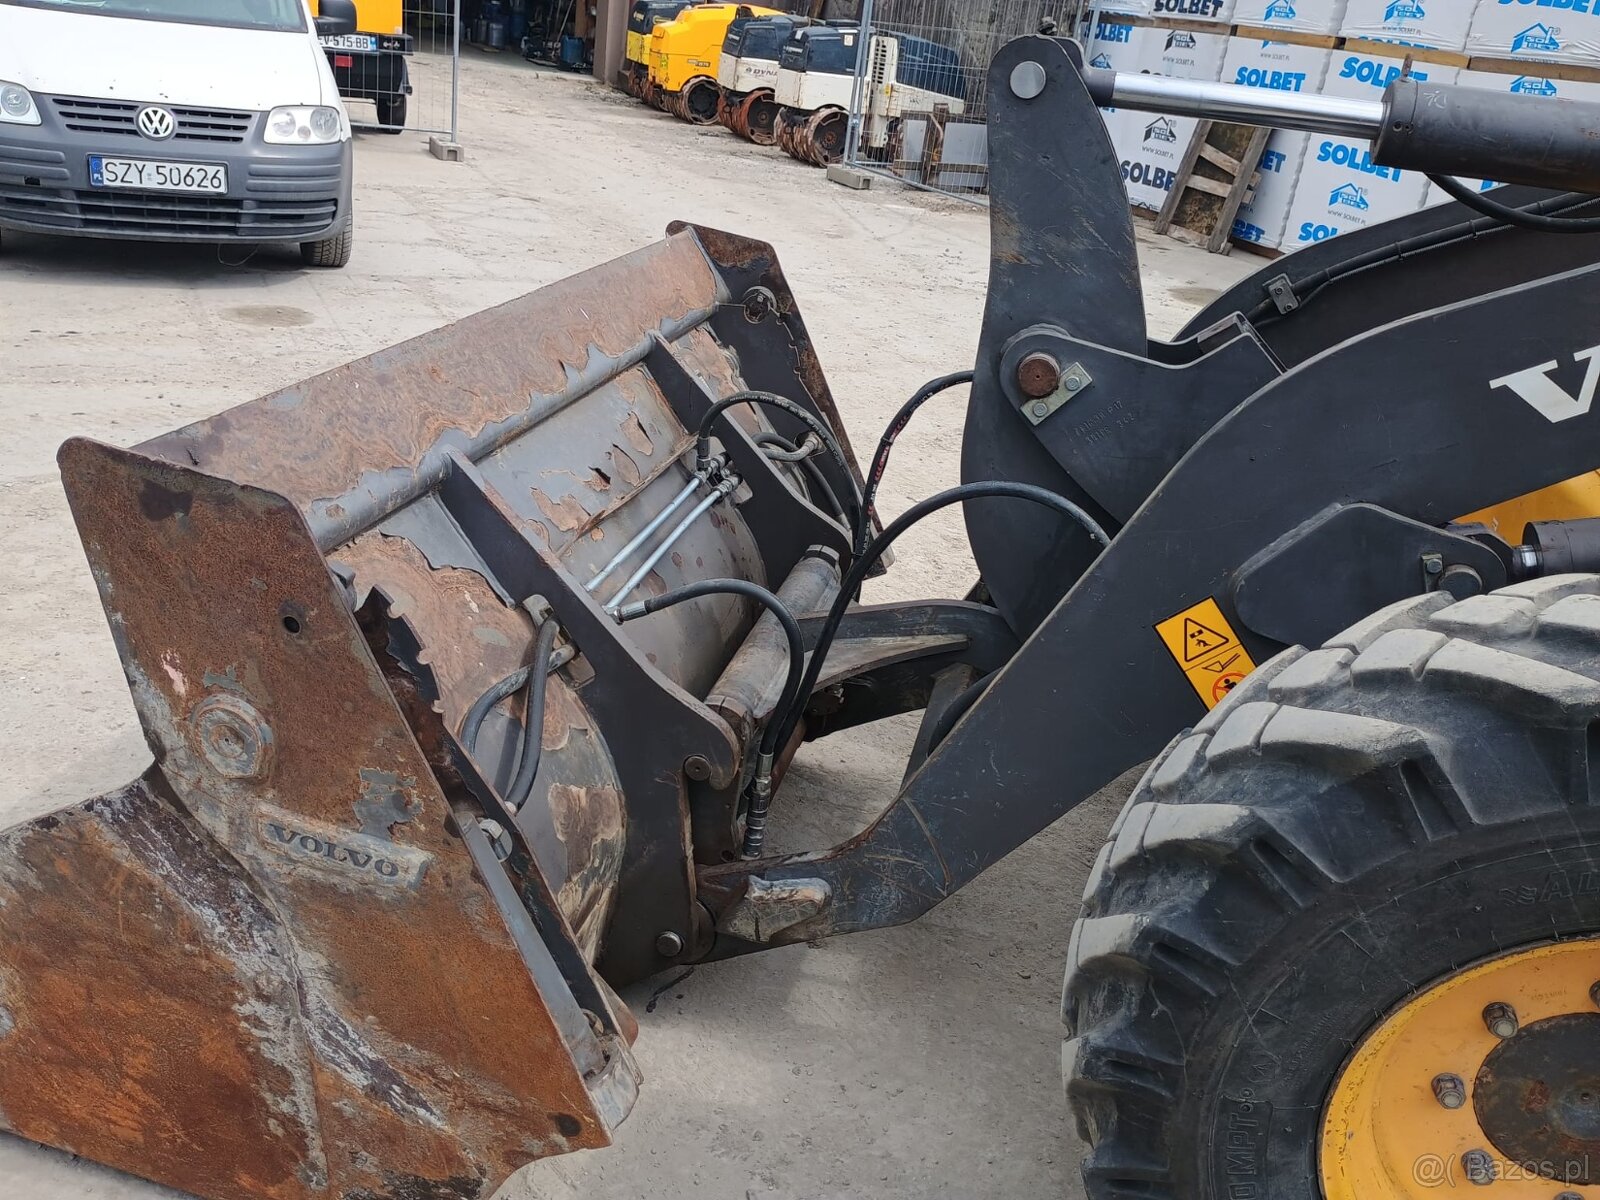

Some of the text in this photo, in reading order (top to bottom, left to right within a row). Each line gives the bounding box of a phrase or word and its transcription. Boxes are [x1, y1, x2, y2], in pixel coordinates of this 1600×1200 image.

[1153, 0, 1224, 17] SOLBET
[1084, 23, 1132, 43] OLBET
[1234, 66, 1306, 92] SOLBET
[104, 161, 222, 189] SZY 50626
[268, 822, 399, 878] VOLVO
